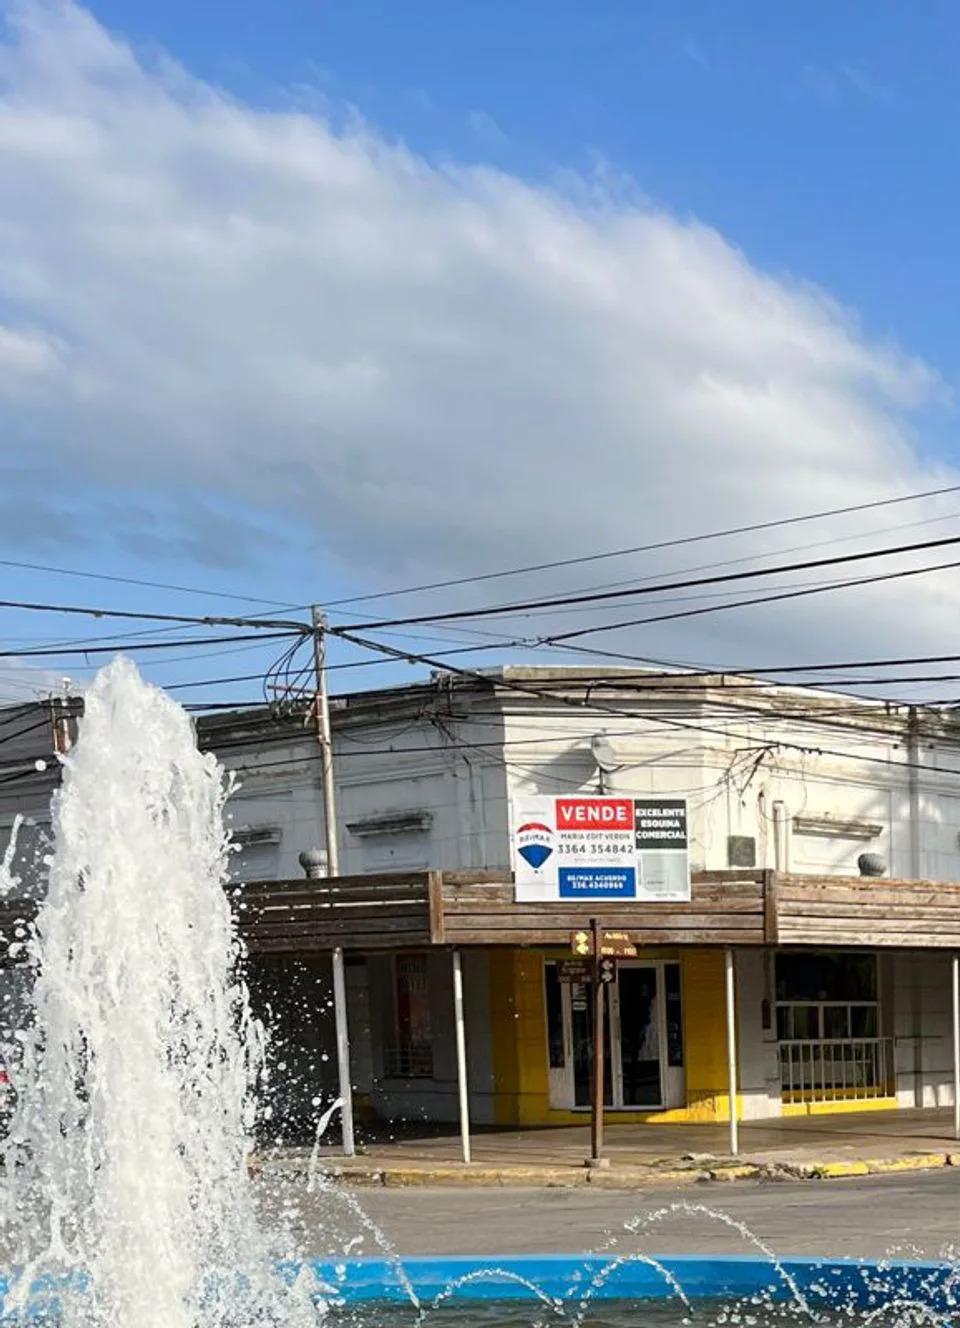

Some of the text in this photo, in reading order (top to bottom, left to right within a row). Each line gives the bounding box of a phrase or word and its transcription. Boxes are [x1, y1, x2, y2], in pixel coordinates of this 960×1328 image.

[561, 806, 627, 821] VENDE
[635, 808, 685, 817] EXCELENTE
[640, 819, 680, 828] ESQUINA
[519, 834, 551, 843] RE/MAX
[636, 831, 687, 840] COMERCIAL
[557, 844, 634, 854] 3364 354842
